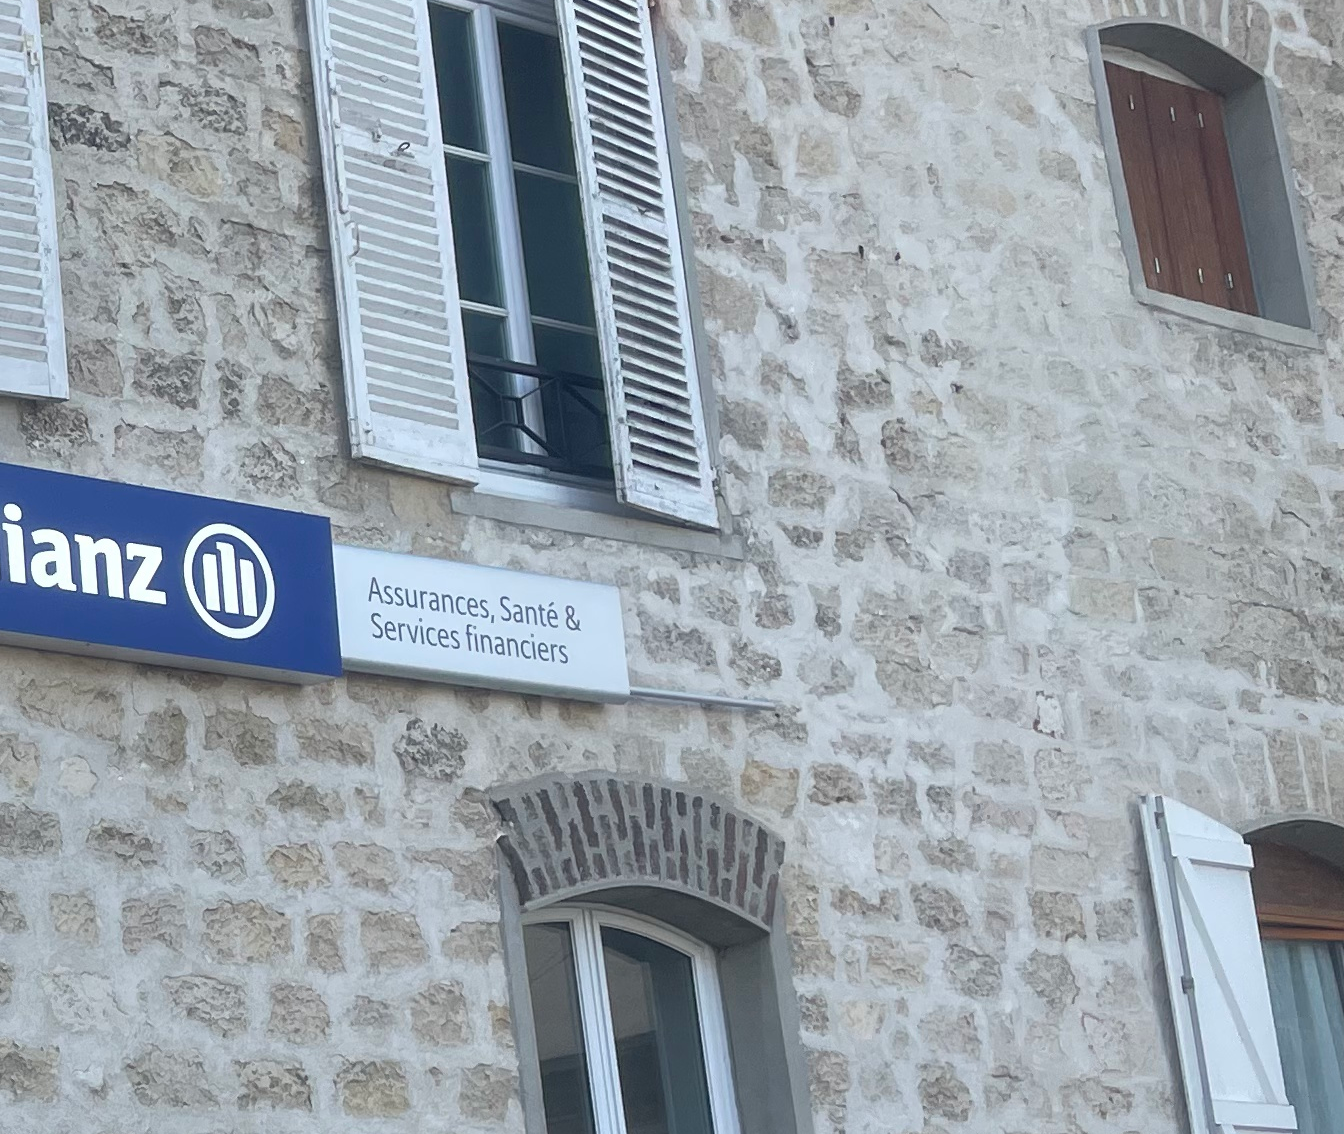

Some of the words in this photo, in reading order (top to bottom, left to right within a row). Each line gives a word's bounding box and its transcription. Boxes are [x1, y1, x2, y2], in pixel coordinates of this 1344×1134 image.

[368, 577, 496, 623] Assurances,
[500, 596, 559, 628] Santé
[565, 605, 582, 631] &
[370, 613, 460, 649] Services
[466, 625, 569, 664] financiers
